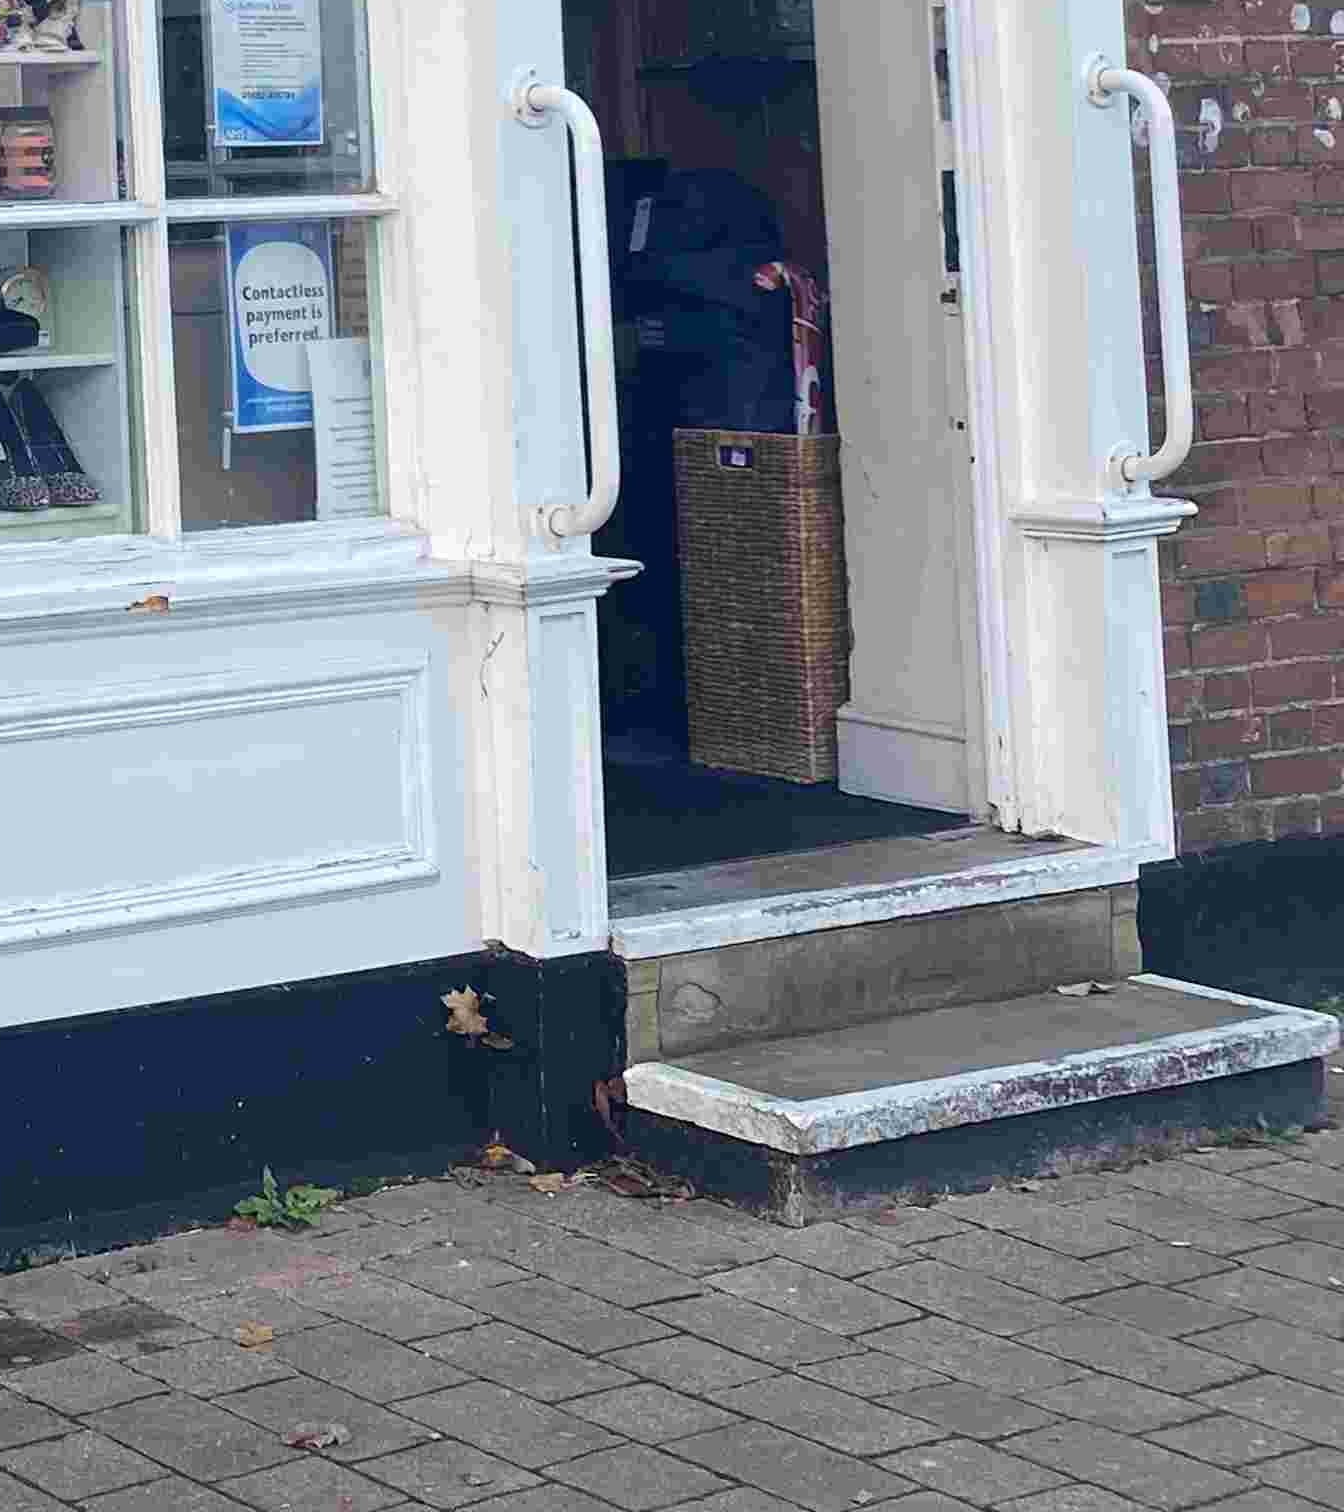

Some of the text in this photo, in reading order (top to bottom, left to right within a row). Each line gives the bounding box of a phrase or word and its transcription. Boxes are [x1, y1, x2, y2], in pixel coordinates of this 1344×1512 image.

[242, 283, 325, 301] Contactless
[246, 304, 323, 326] payment is
[249, 326, 324, 348] preferred.
